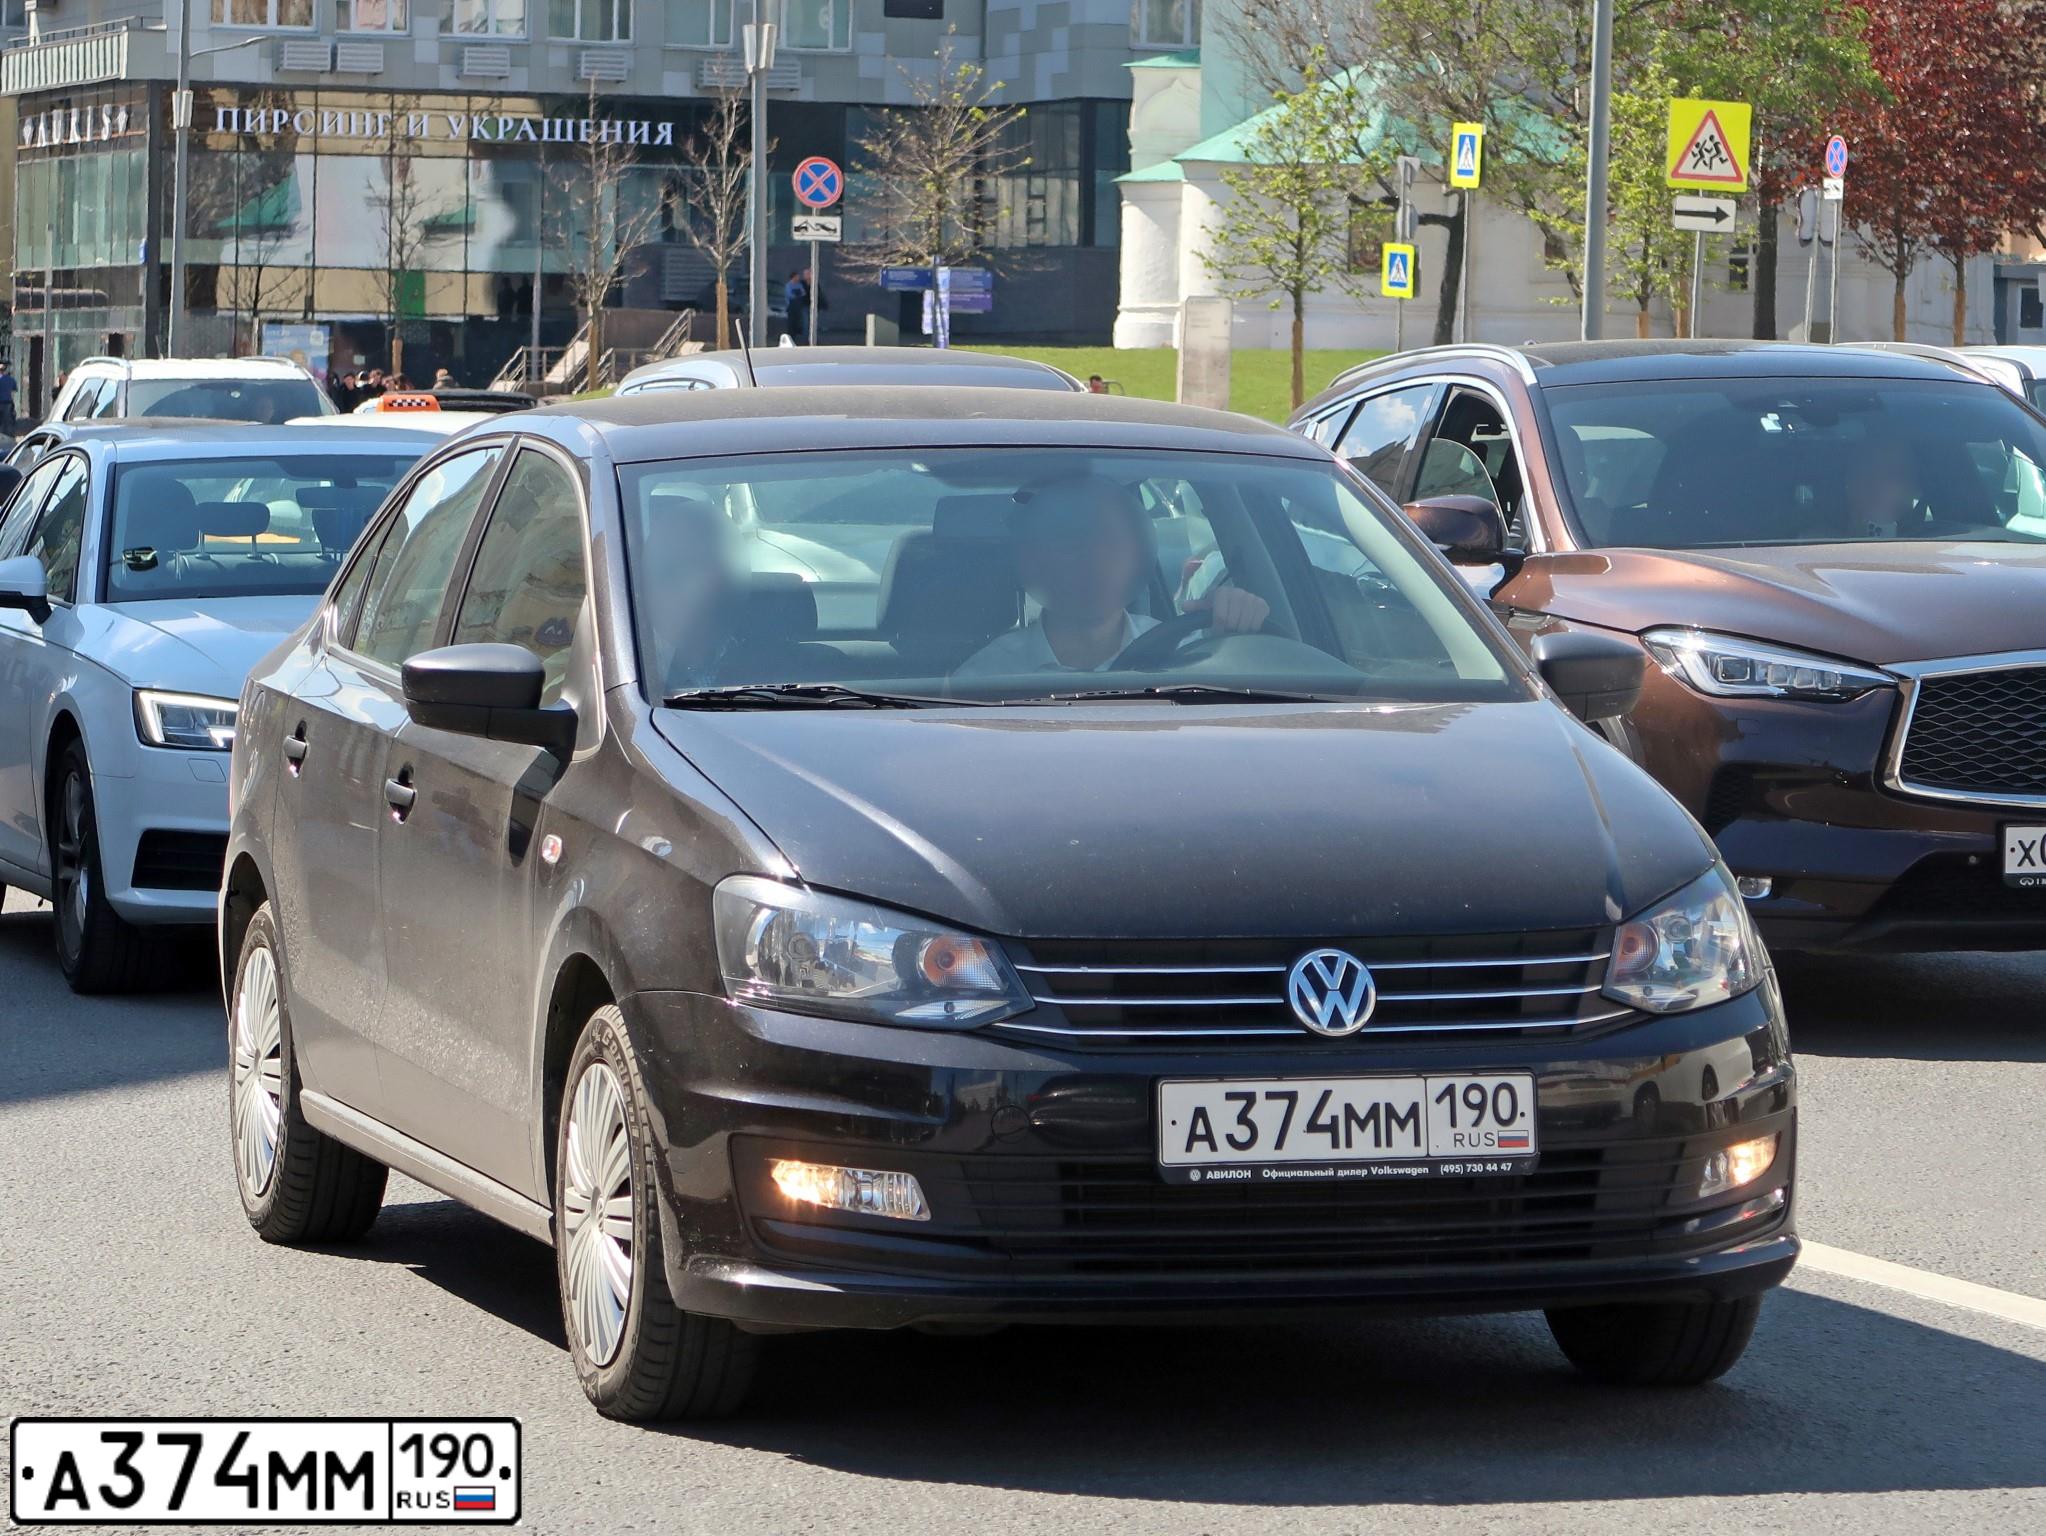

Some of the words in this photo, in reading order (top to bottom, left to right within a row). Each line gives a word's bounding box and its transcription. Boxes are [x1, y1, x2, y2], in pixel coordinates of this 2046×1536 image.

[215, 107, 391, 138] ПИРСИНГ
[407, 113, 430, 139] И
[447, 114, 675, 146] УКРАШЕНИЯ
[1435, 1082, 1519, 1128] 190
[1453, 1131, 1496, 1148] RUS
[1206, 1170, 1252, 1180] АВИЛОН
[1263, 1168, 1335, 1180] Официальный
[1338, 1168, 1368, 1178] дилер
[1371, 1166, 1429, 1177] Volkswagen
[1440, 1164, 1464, 1175] (495)
[1466, 1163, 1484, 1173] 730
[1486, 1163, 1499, 1172] 44
[1500, 1162, 1513, 1172] 47
